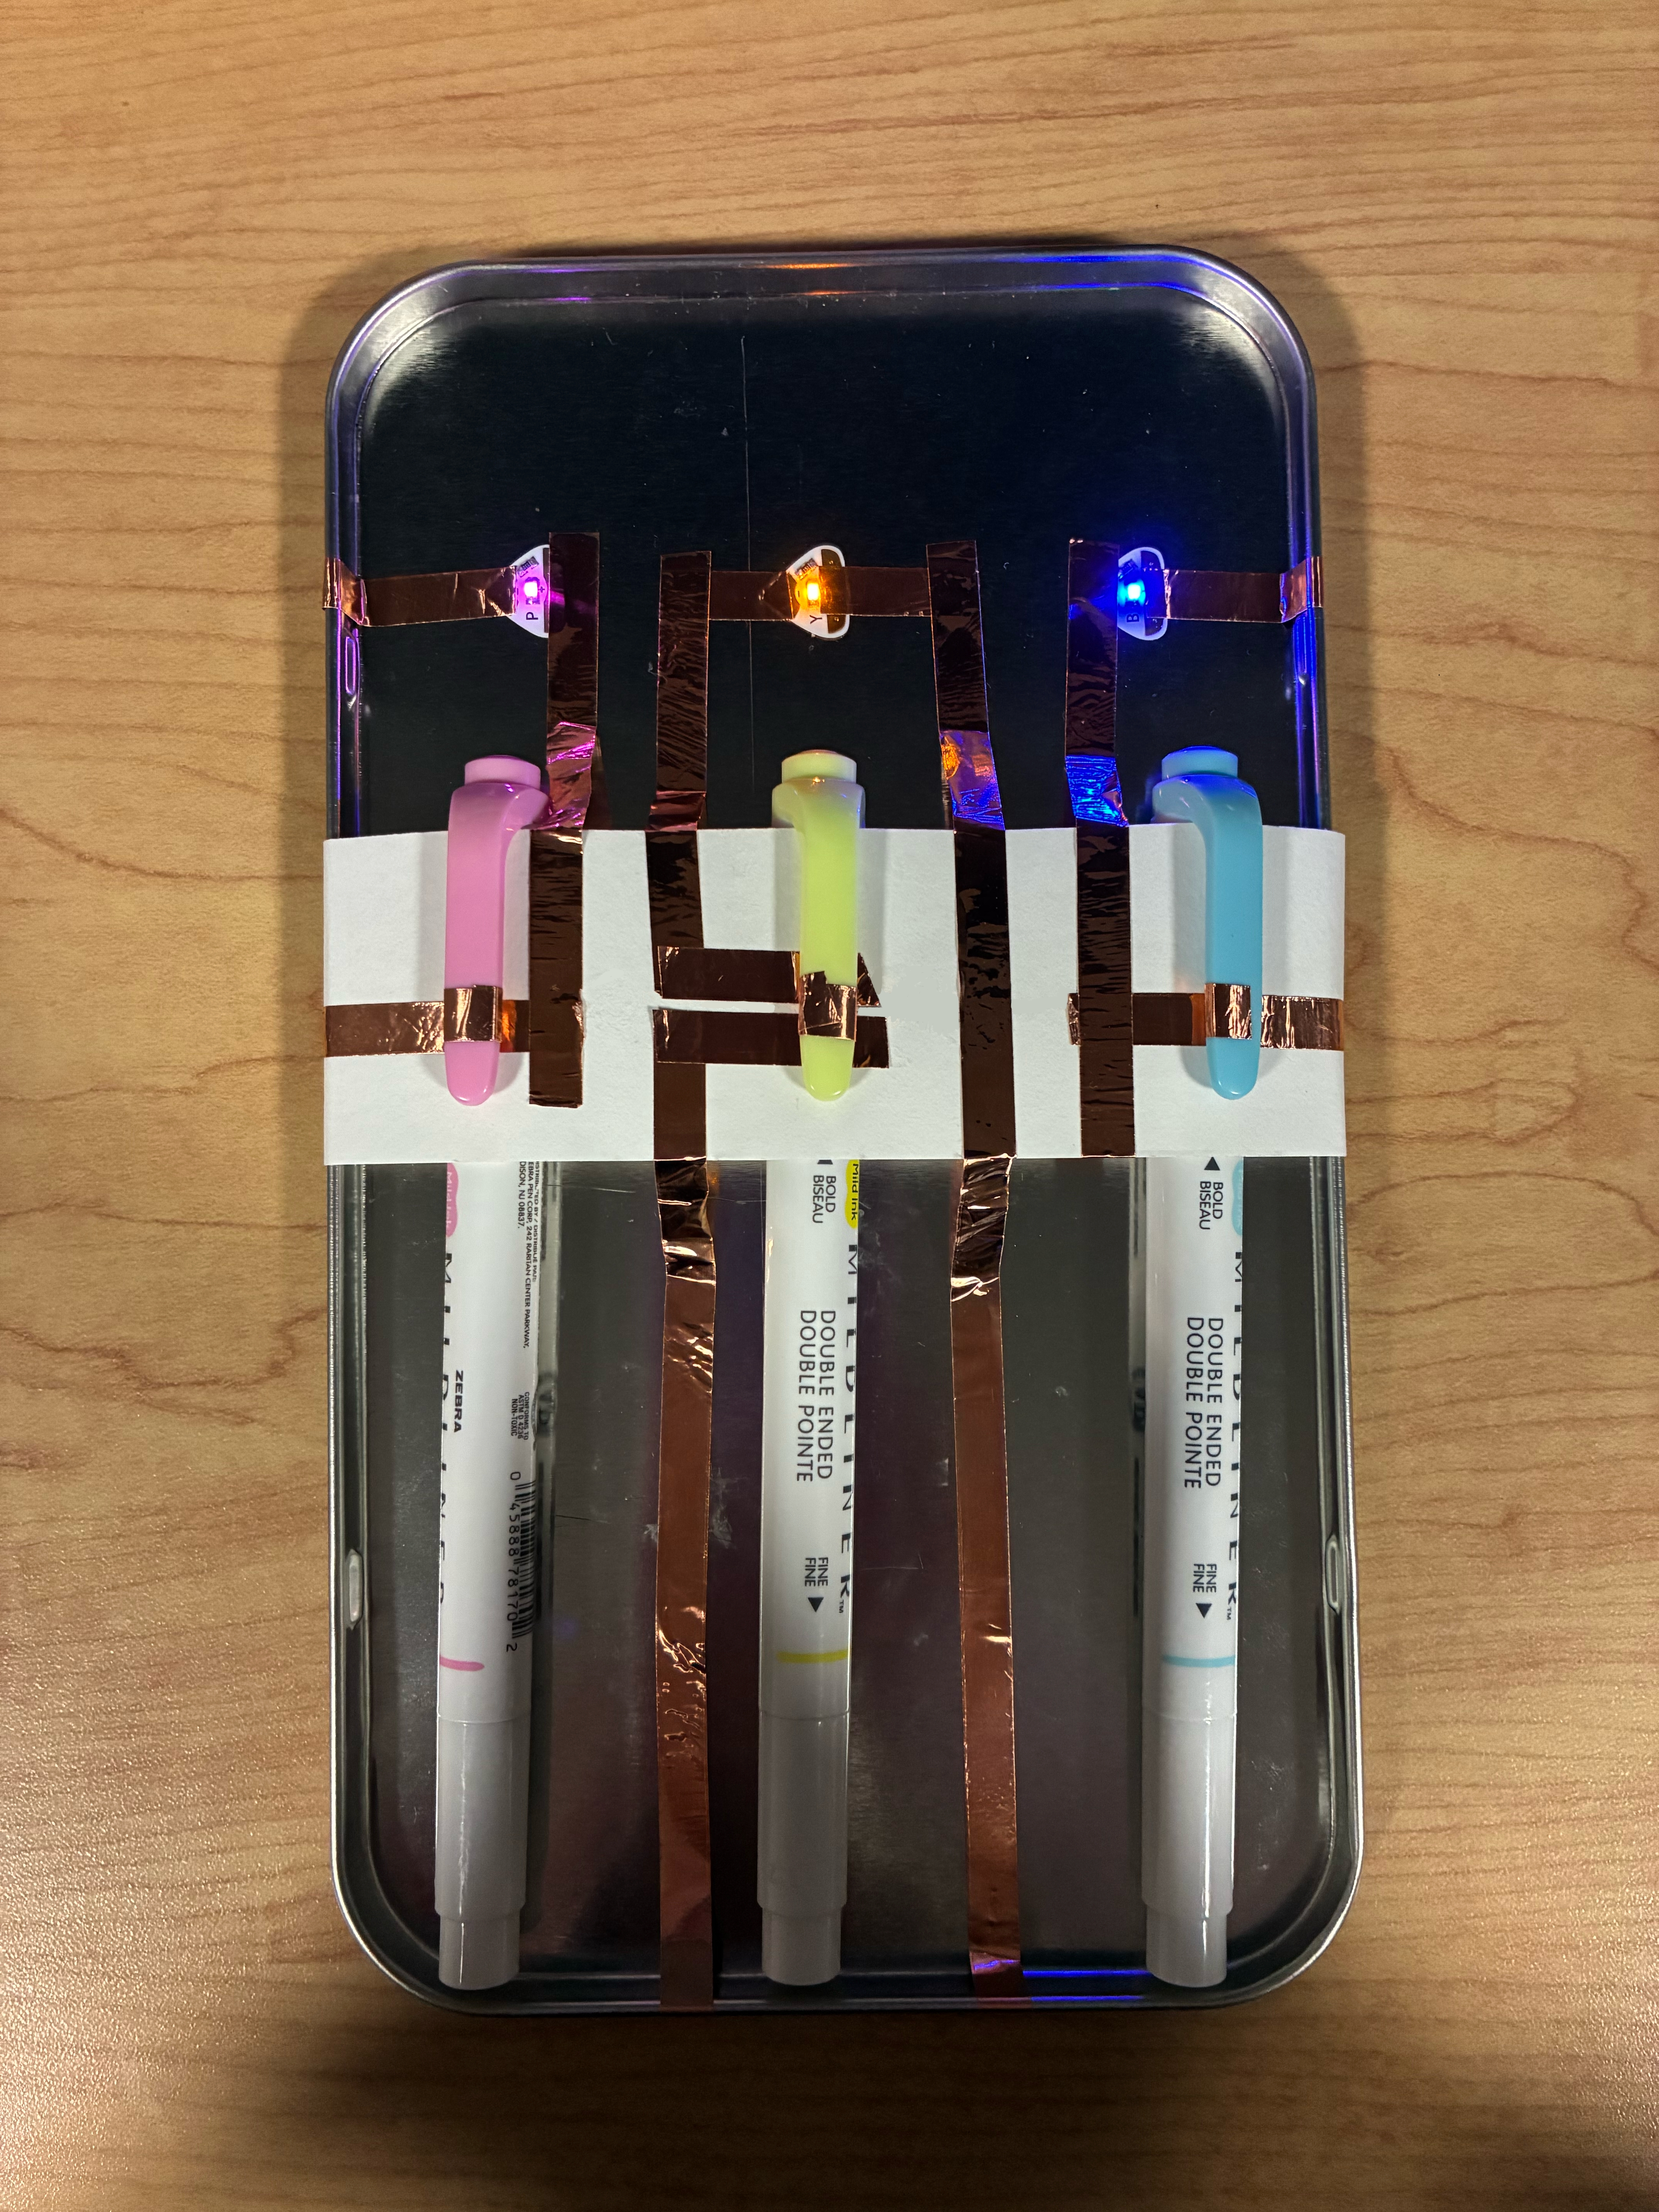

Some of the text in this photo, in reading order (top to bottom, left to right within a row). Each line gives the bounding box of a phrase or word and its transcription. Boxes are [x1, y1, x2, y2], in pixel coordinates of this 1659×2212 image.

[526, 612, 538, 620] P
[810, 615, 822, 624] Y
[1127, 614, 1139, 622] B
[518, 1161, 527, 1187] DISON,
[518, 1190, 526, 1200] NJ
[812, 1175, 825, 1223] BISEAU
[825, 1176, 836, 1213] BOLD
[1199, 1181, 1211, 1230] BISEAU
[1212, 1182, 1224, 1219] BOLD
[534, 1207, 538, 1217] BY
[453, 1369, 464, 1433] ZEBRA
[796, 1310, 817, 1482] DOUBLE POINTE
[817, 1310, 836, 1479] DOUBLE ENDED
[1184, 1317, 1204, 1489] DOUBLE POINTE
[1206, 1317, 1223, 1486] DOUBLE ENDED
[523, 1431, 529, 1441] TO
[506, 1471, 521, 1653] 0 45888 78170 2
[805, 1558, 816, 1587] FINE
[817, 1557, 829, 1587] FINE
[1193, 1563, 1205, 1593] FINE
[1206, 1564, 1217, 1593] FINE
